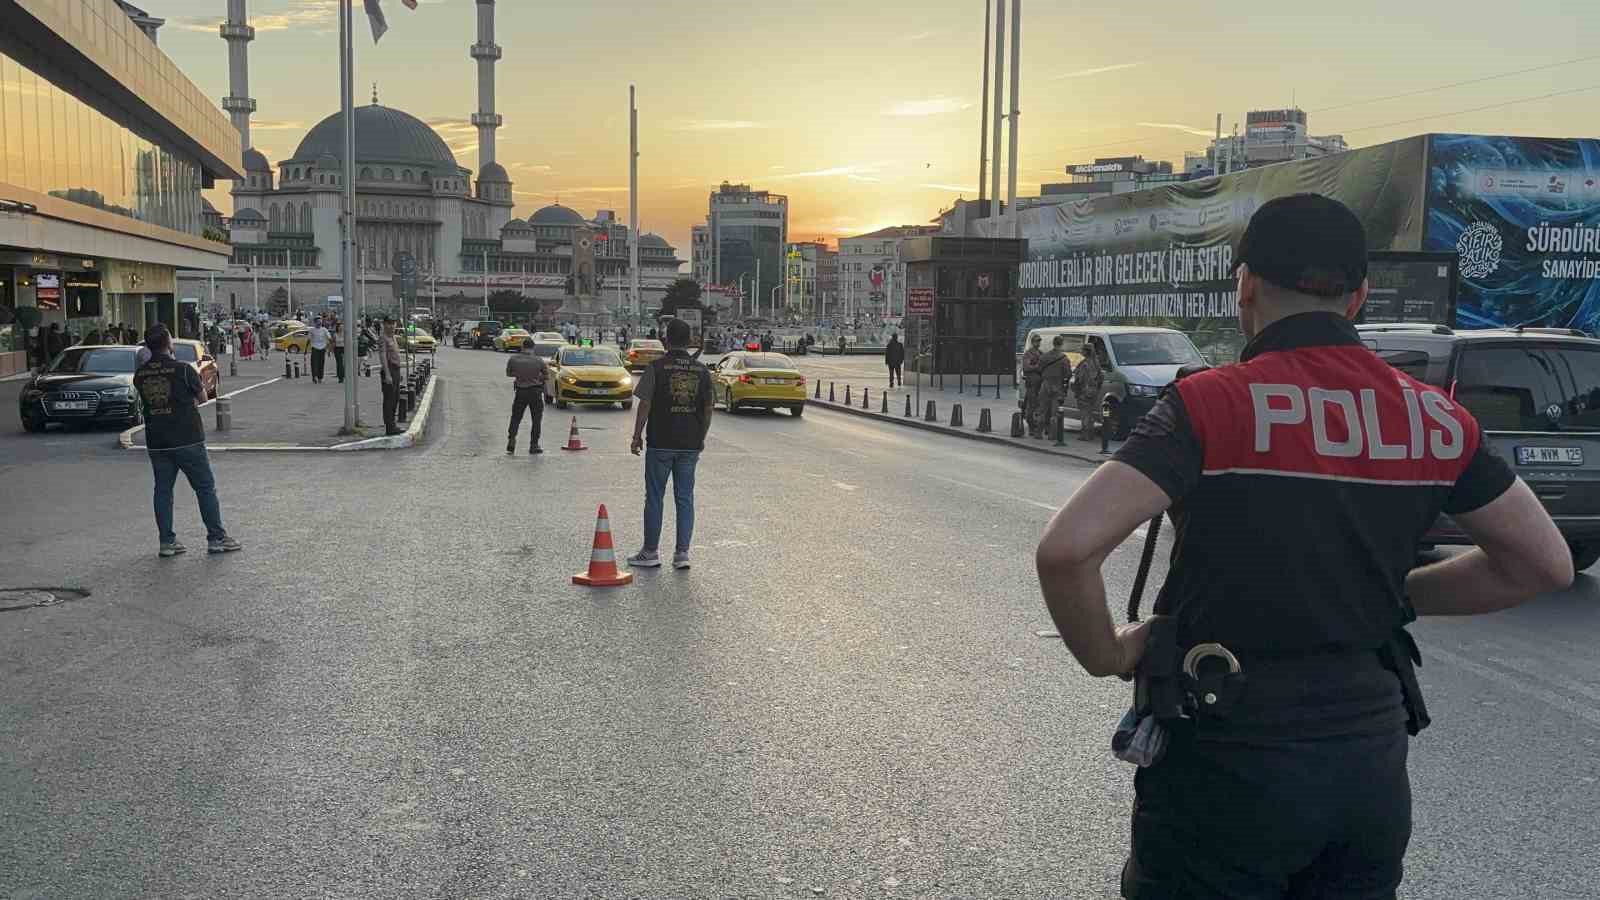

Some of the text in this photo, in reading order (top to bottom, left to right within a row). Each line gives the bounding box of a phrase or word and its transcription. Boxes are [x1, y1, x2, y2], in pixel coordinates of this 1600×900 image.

[1095, 249, 1114, 286] BİR
[1115, 251, 1166, 284] GELECEK
[1169, 242, 1194, 288] İÇİN
[1197, 245, 1232, 281] SIFIR
[1022, 293, 1060, 317] SANAYİDEN
[1092, 294, 1126, 317] GIDADAN
[1128, 293, 1183, 317] HAYATIMIZIN
[1186, 292, 1206, 317] HER
[1249, 378, 1465, 460] POLİS
